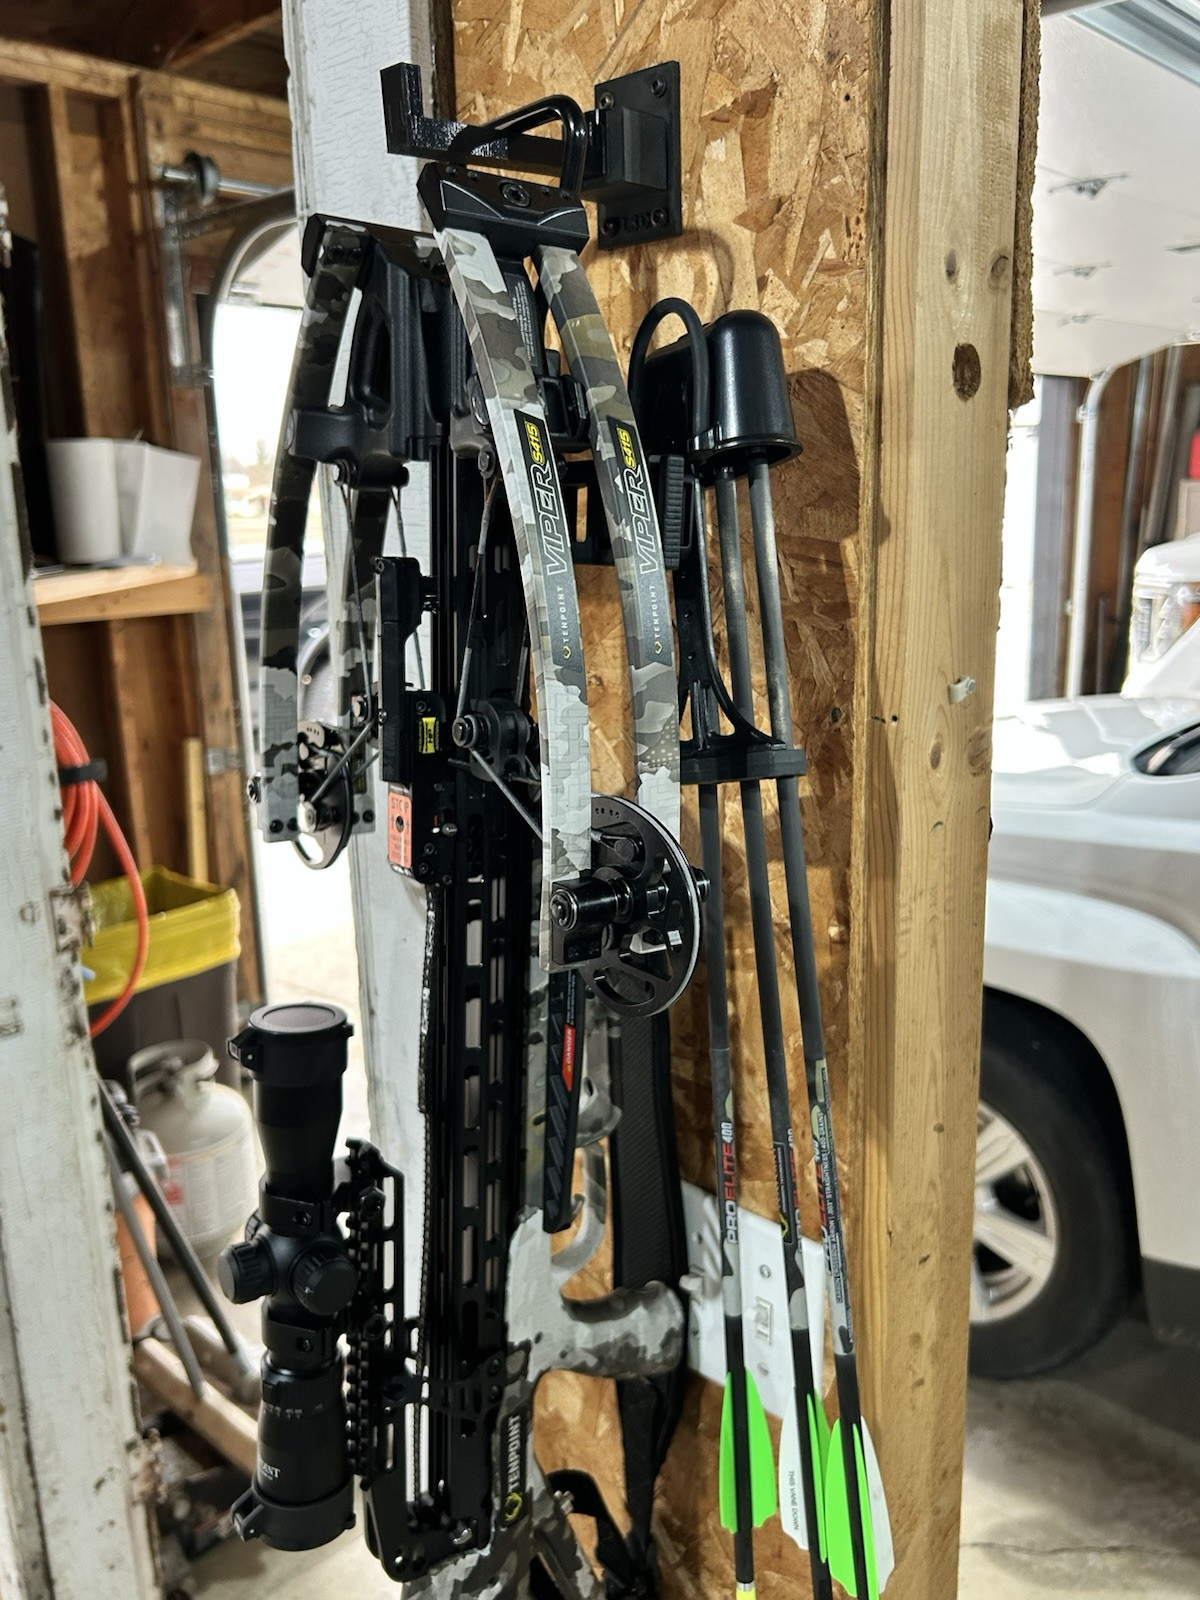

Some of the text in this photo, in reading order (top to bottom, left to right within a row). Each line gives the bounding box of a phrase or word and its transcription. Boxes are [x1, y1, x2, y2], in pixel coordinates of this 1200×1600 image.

[525, 420, 567, 576] VIPER S415
[617, 426, 659, 575] VIPER S415
[557, 585, 569, 643] TENPOINT
[650, 584, 662, 639] TENPOINT
[720, 1121, 734, 1144] 400
[507, 1414, 521, 1494] TENPOINT
[790, 1487, 798, 1507] VANE
[792, 1507, 800, 1531] DOWN
